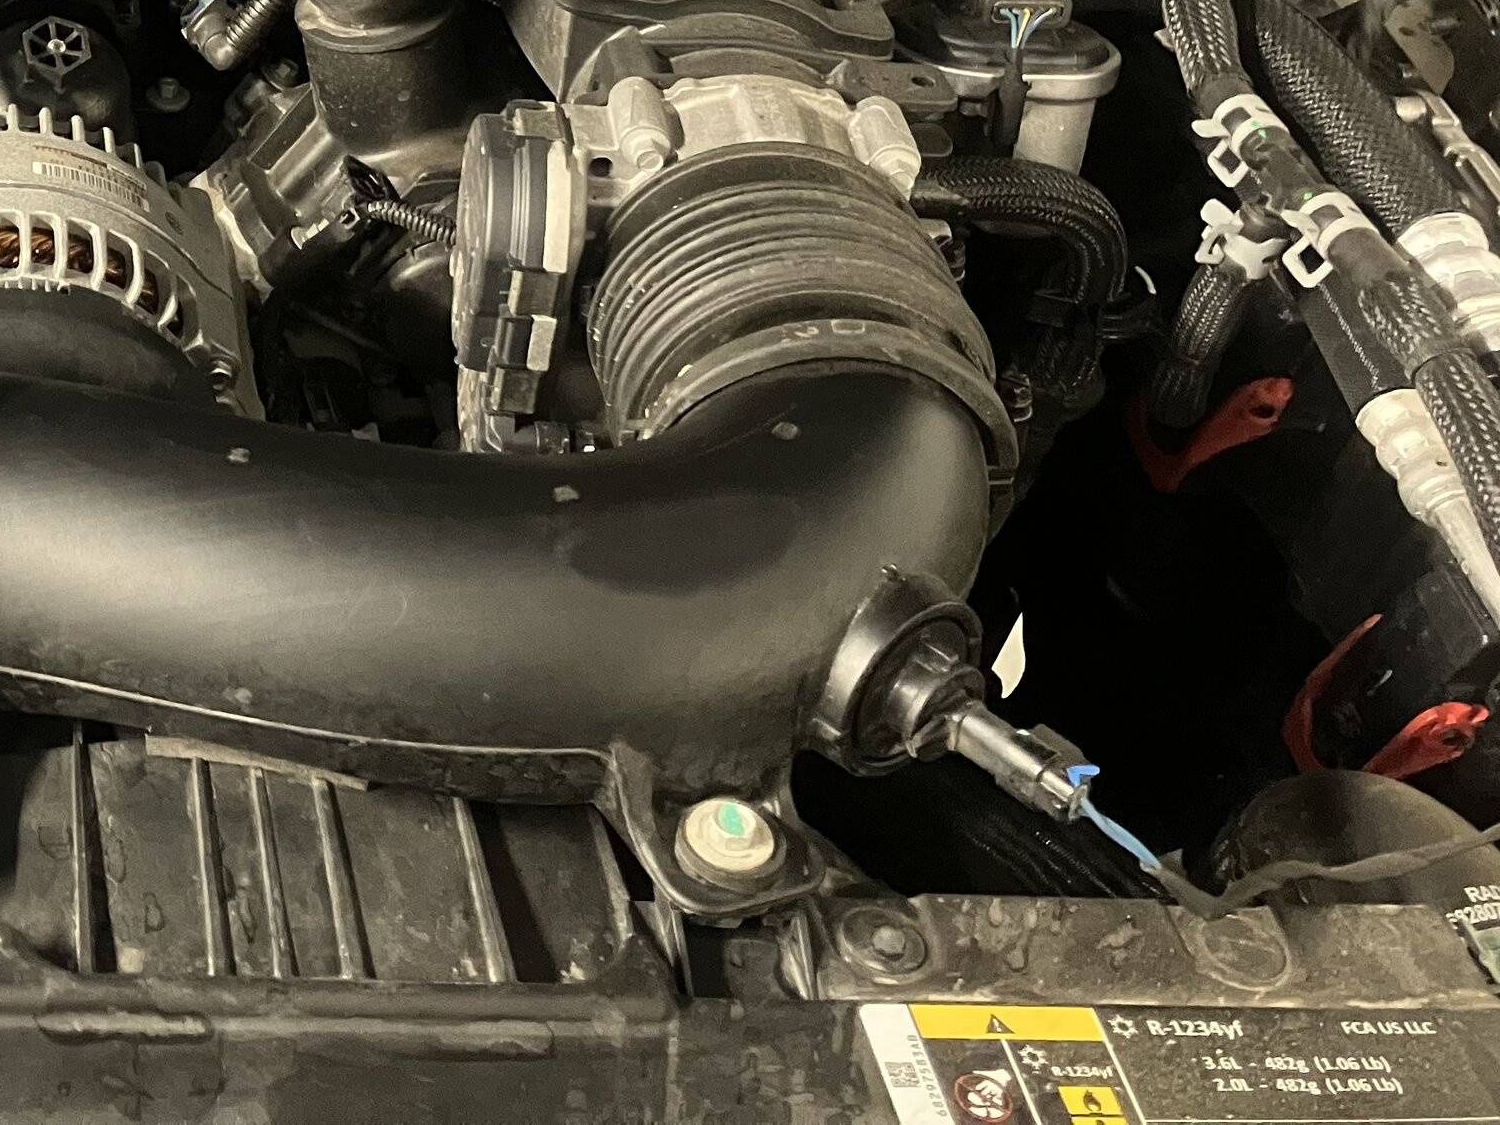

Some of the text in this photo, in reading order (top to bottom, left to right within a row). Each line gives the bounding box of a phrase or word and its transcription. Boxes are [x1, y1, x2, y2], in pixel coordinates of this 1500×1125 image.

[1146, 1019, 1437, 1041] R-1234yf FCA US LLC
[1050, 1065, 1114, 1080] R-1234yf
[1201, 1056, 1243, 1071] 3.6L
[1264, 1056, 1310, 1074] 482g
[1314, 1056, 1360, 1073] (1.06
[1214, 1077, 1253, 1092] 2.0L
[1276, 1077, 1321, 1095] 482g
[1325, 1077, 1372, 1094] (1.06
